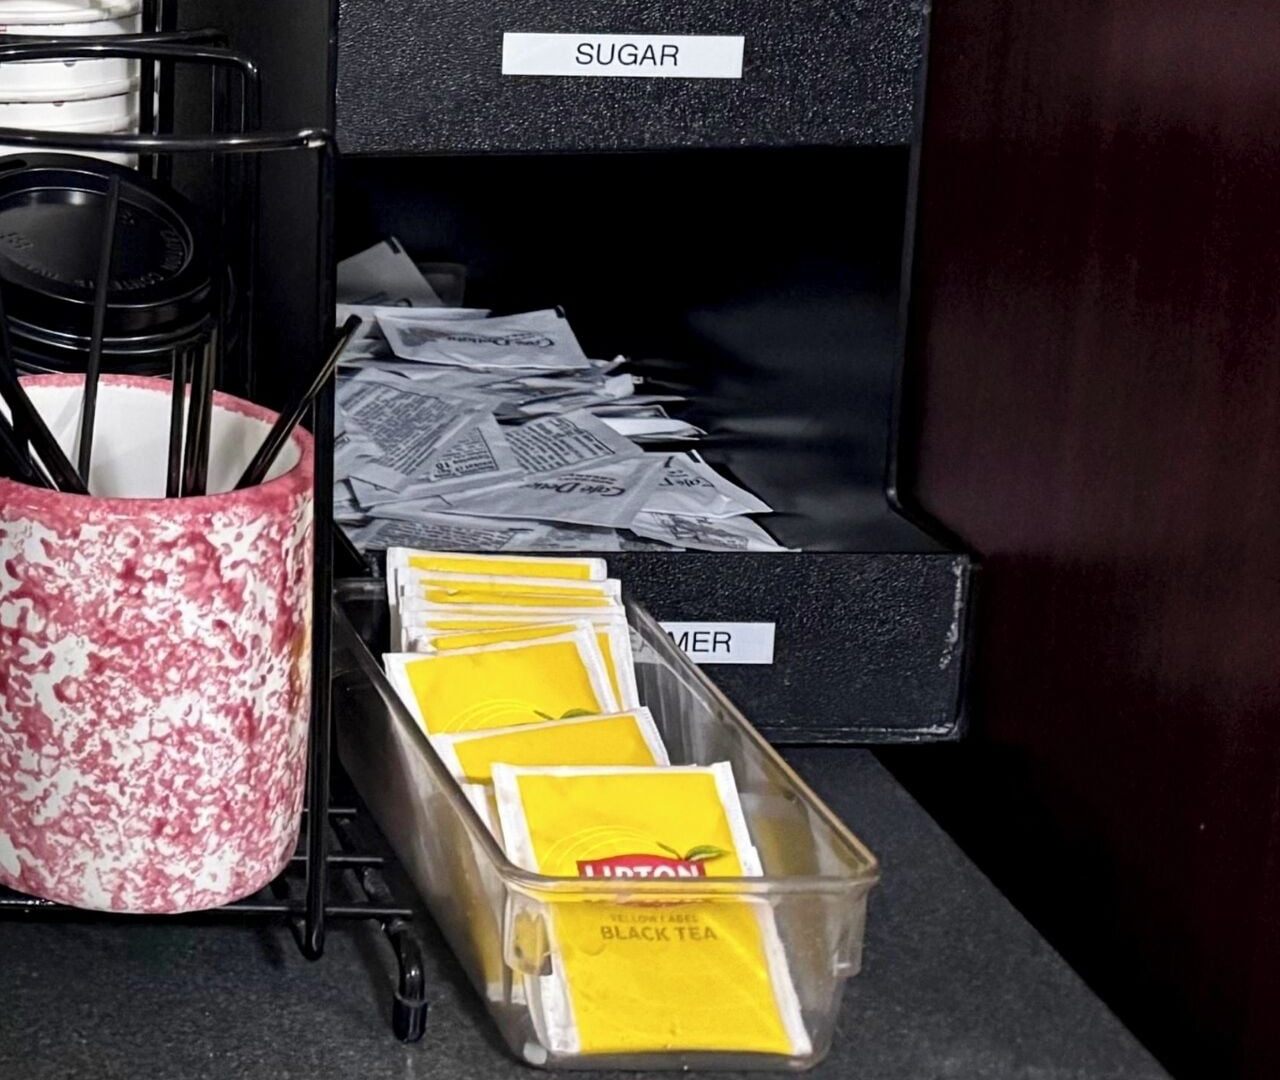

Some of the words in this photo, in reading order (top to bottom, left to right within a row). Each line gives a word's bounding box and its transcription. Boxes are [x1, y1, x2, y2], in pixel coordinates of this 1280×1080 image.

[574, 42, 680, 68] SUGAR
[667, 631, 732, 654] MER
[600, 925, 670, 942] BLACK
[674, 925, 719, 942] TEA
